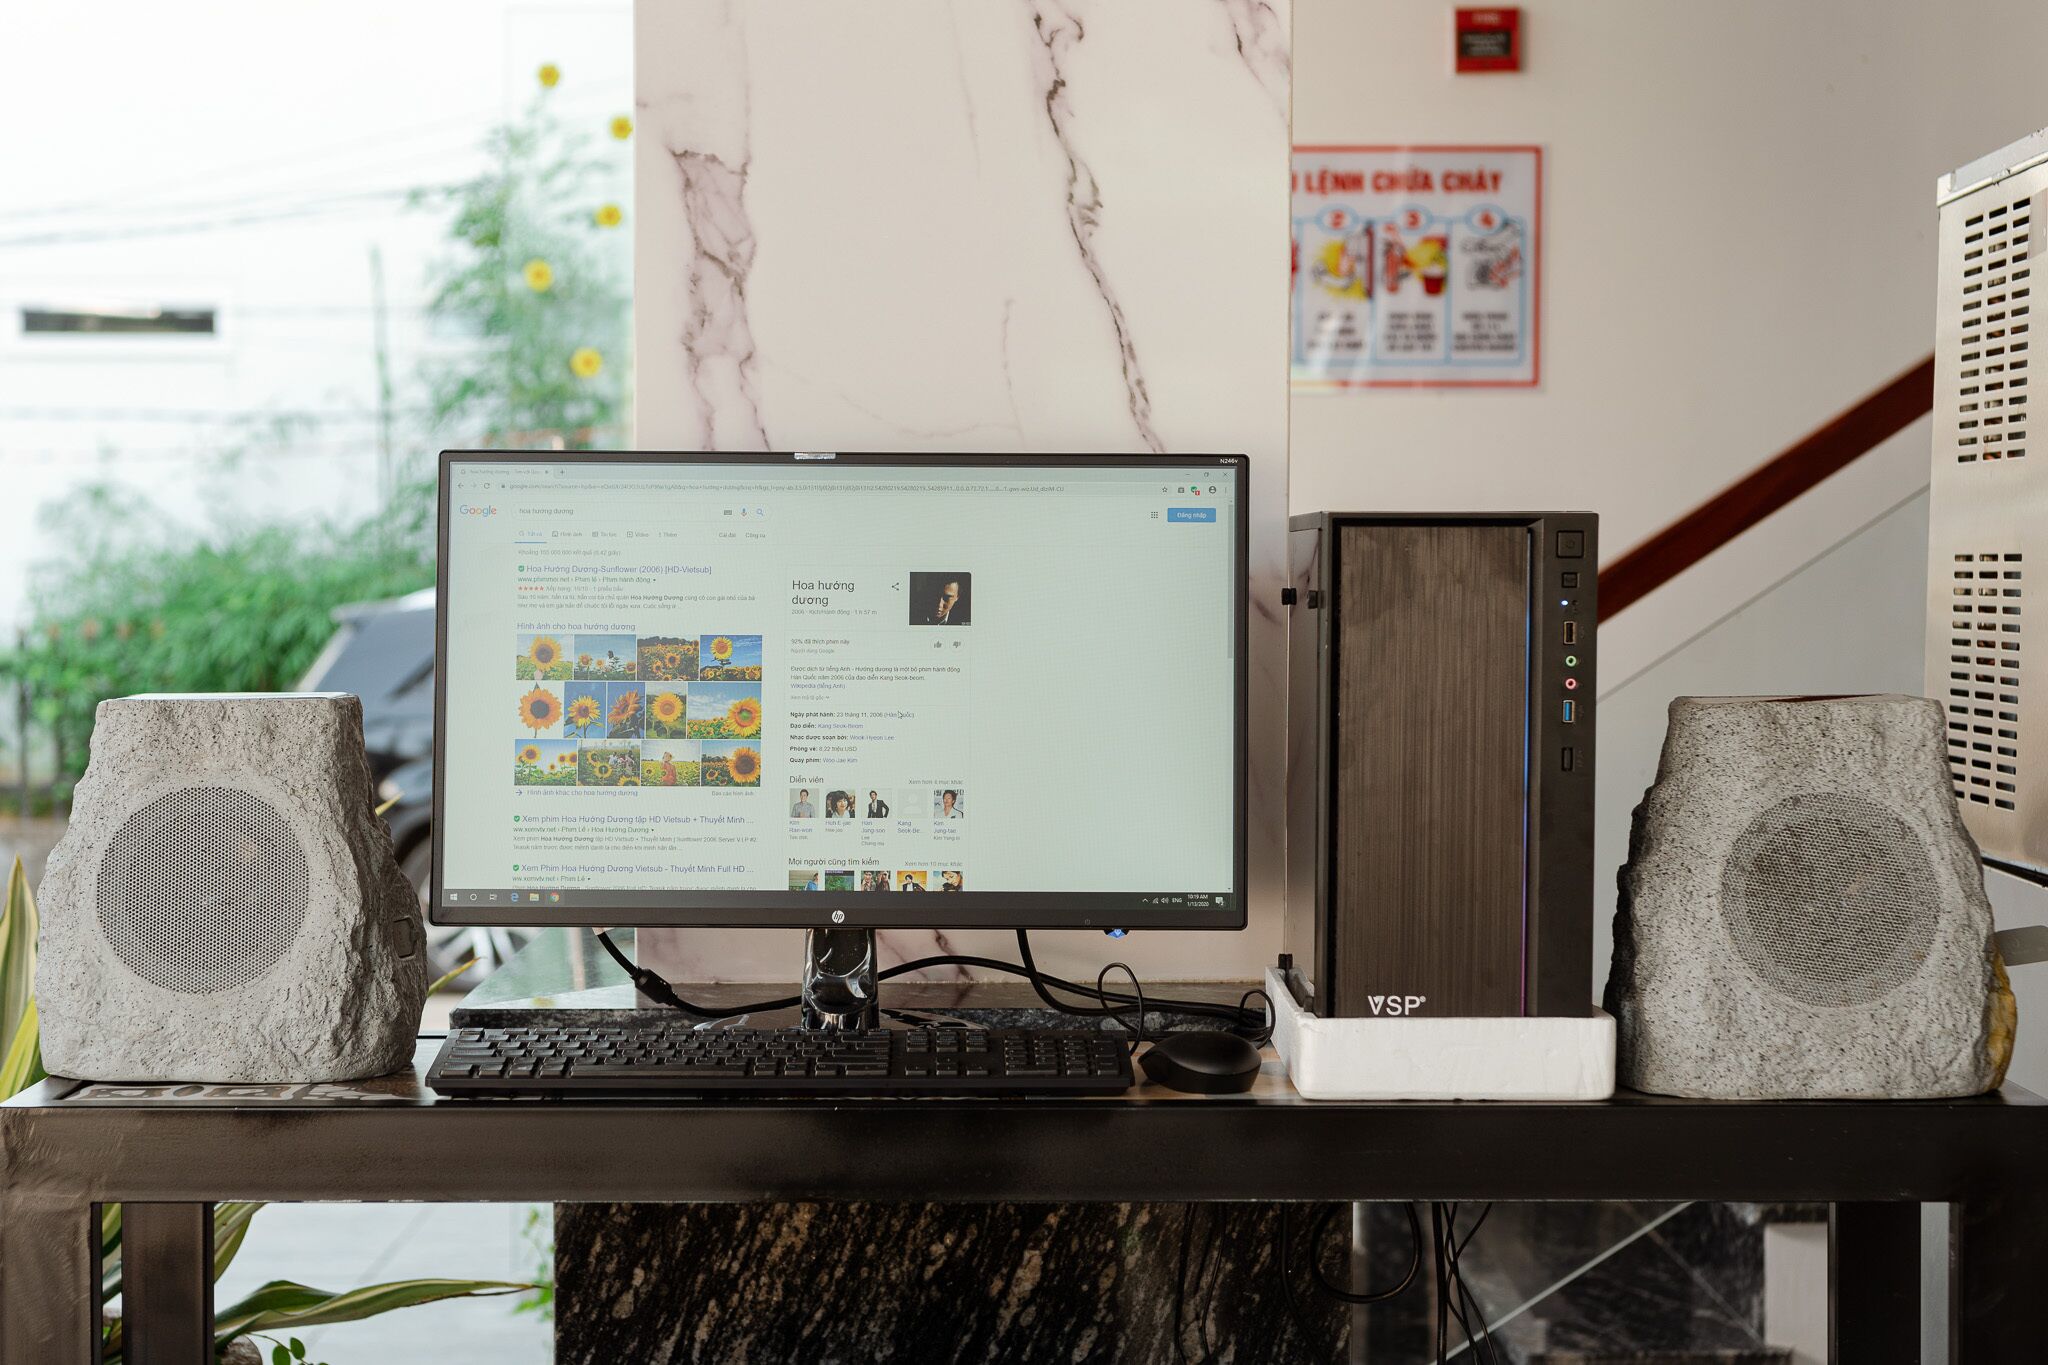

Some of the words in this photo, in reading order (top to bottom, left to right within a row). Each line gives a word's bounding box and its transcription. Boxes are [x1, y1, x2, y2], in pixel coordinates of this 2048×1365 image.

[460, 504, 497, 518] Google
[792, 581, 815, 590] Hoa
[818, 580, 855, 593] hướng
[792, 595, 829, 607] dương
